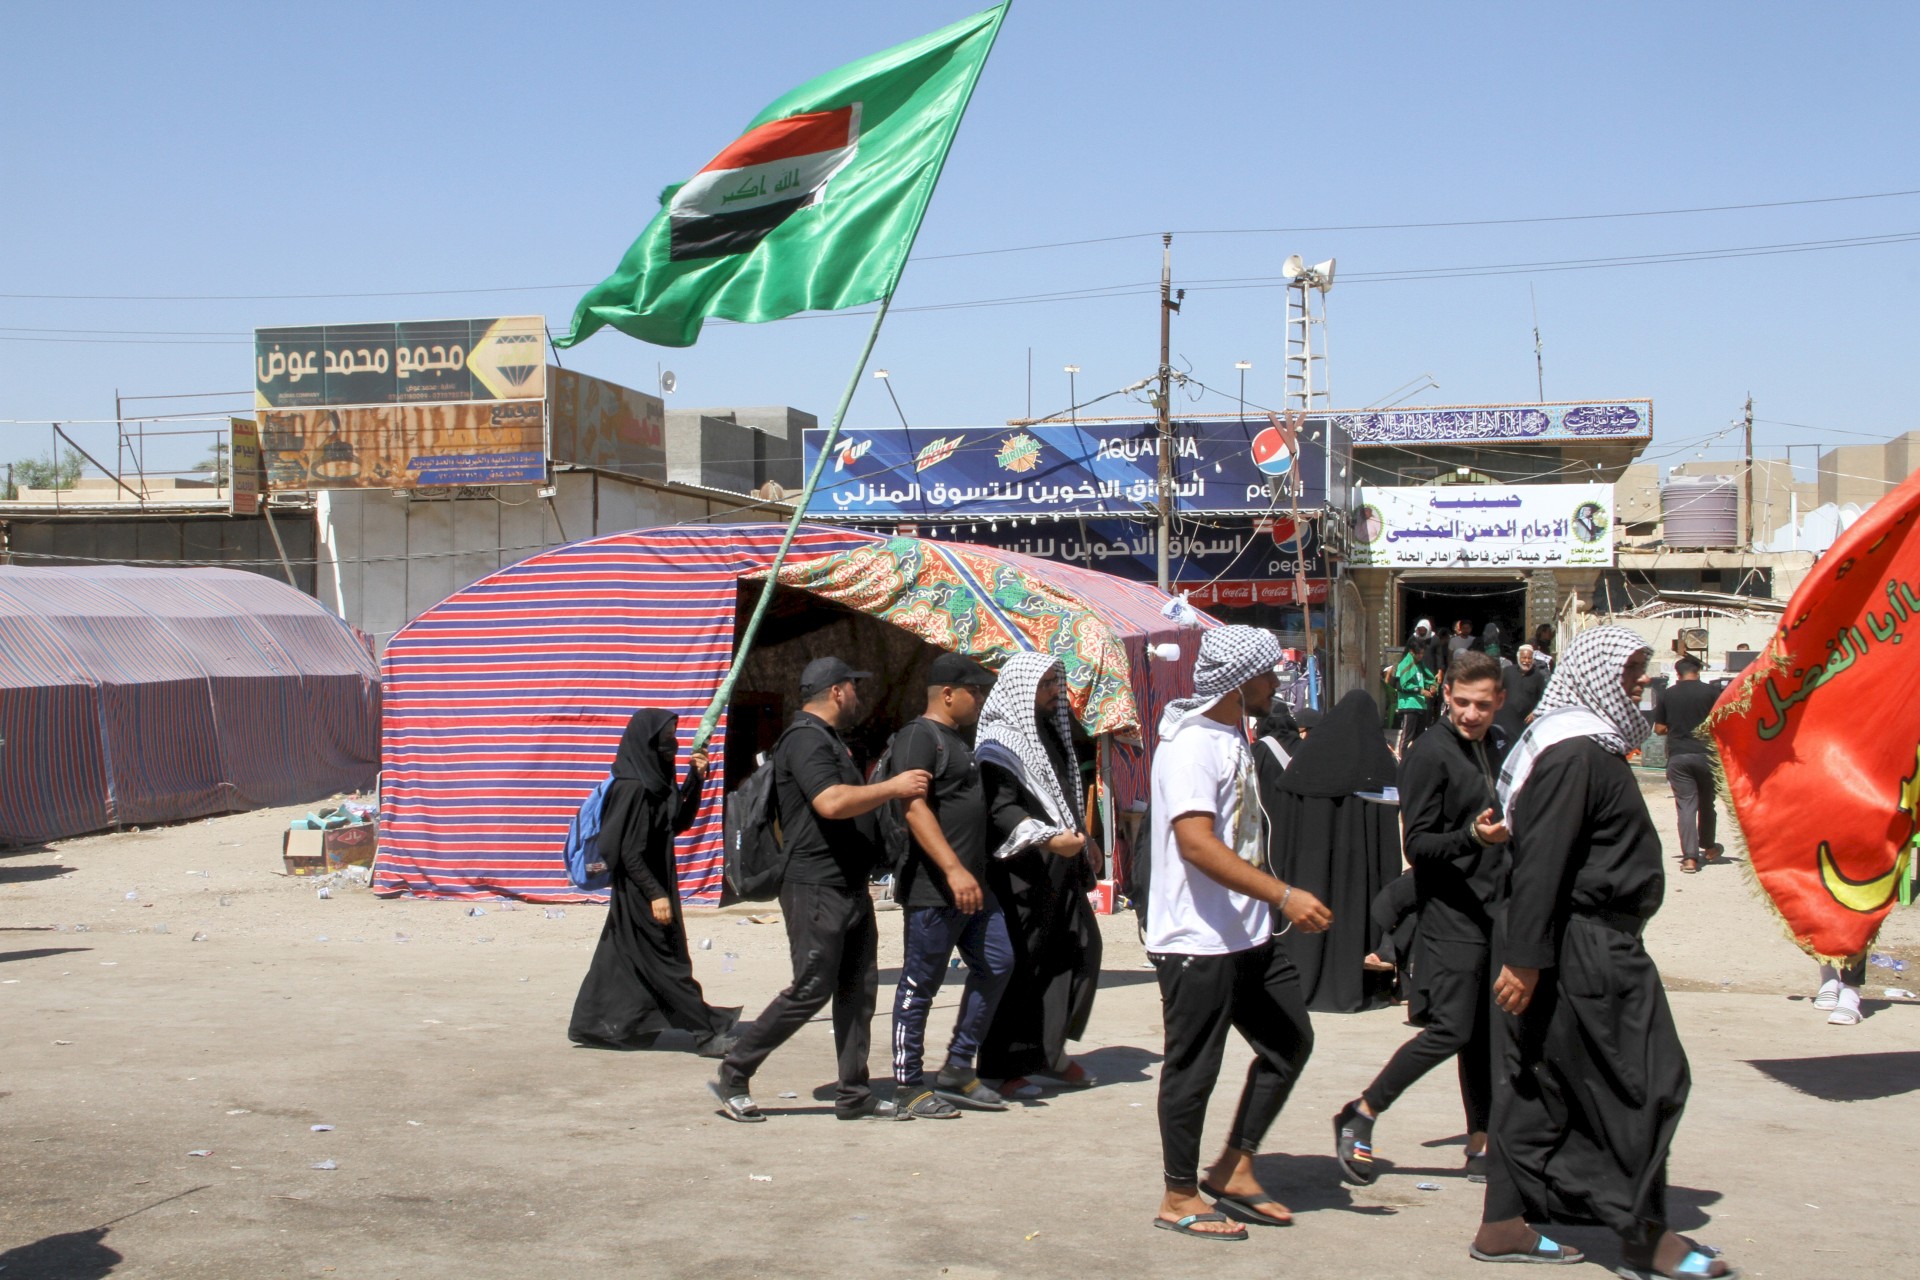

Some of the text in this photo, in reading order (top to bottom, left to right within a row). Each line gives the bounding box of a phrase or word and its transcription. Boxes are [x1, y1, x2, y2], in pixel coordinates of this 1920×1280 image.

[774, 168, 799, 192] الله
[258, 344, 318, 383] عوض
[324, 348, 389, 375] محمد
[396, 344, 463, 378] مجمع
[998, 439, 1042, 467] MIRINDA
[833, 483, 920, 510] المنزلي
[927, 482, 1022, 504] للتسوق
[1429, 490, 1522, 513] حسينية
[1386, 520, 1459, 542] المجتبى
[1268, 557, 1317, 575] pepsi
[1397, 551, 1423, 562] الحلة
[1456, 550, 1489, 562] فاطمة
[1543, 549, 1562, 564] مقر
[1757, 624, 1869, 740] الفضل
